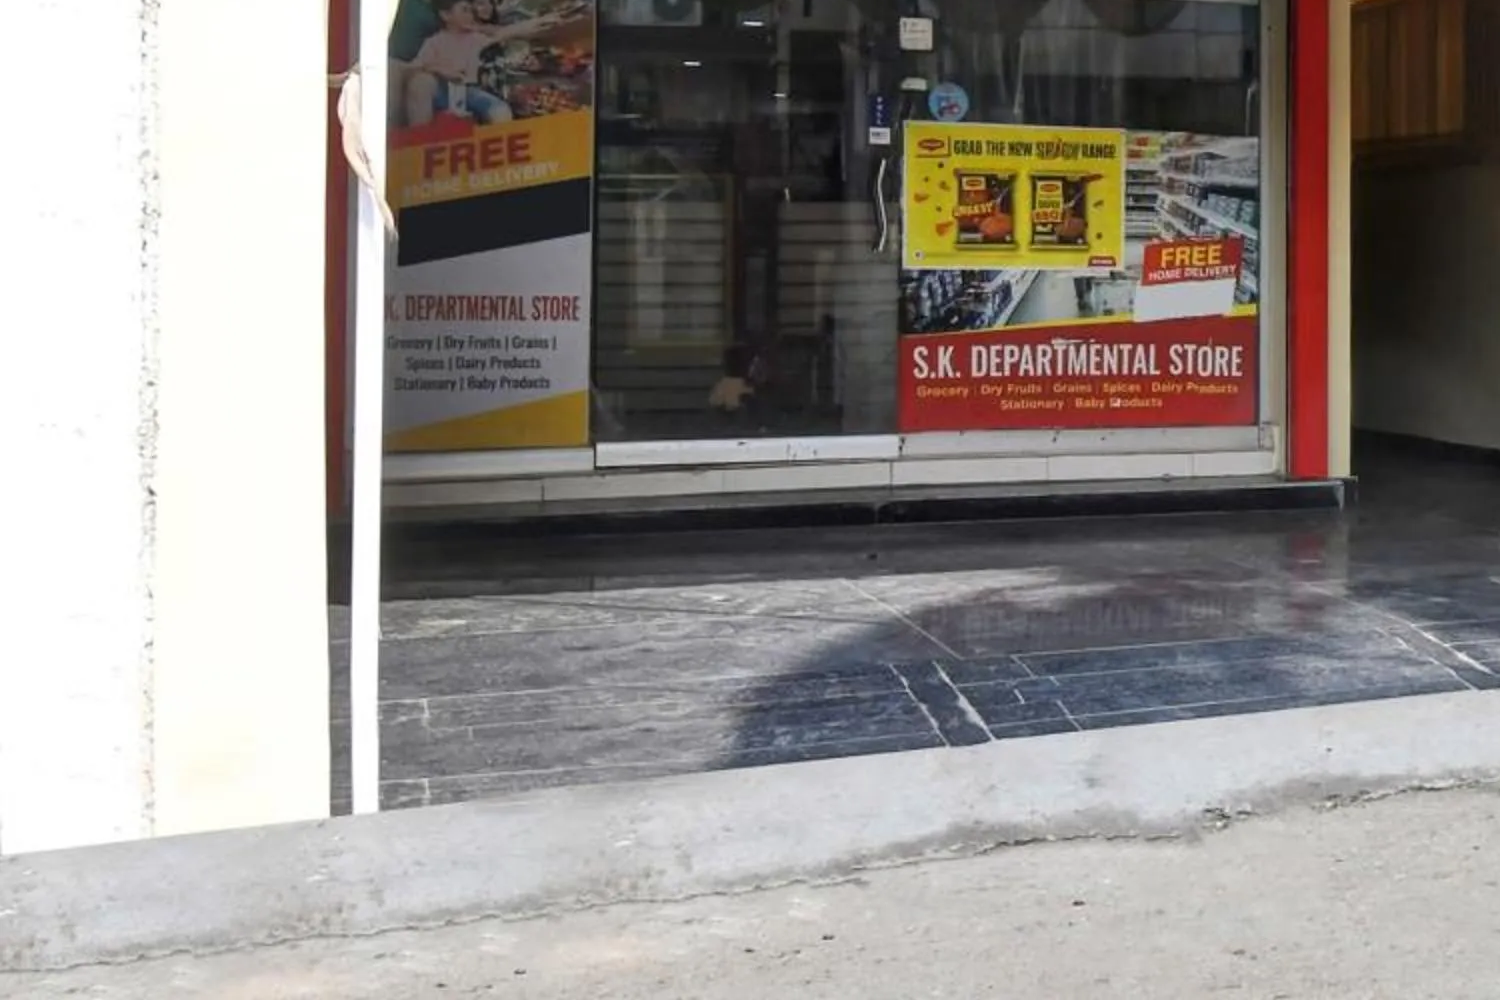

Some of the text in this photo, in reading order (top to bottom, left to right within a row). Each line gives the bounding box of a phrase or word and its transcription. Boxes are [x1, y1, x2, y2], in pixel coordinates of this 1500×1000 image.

[423, 131, 532, 180] FREE
[954, 140, 983, 155] GRAB
[986, 140, 1006, 156] THE
[1009, 141, 1033, 156] NEW
[1082, 143, 1116, 158] RANGE
[470, 161, 560, 188] DELIVERY
[1161, 244, 1223, 267] FREE
[1148, 264, 1237, 281] HOME DELIVERY
[405, 295, 527, 322] DEPARTMENTAL
[531, 296, 581, 322] STORE
[443, 336, 465, 350] Dry
[469, 335, 502, 349] Fruits
[511, 336, 549, 349] Grains
[455, 356, 486, 371] Dairy
[490, 356, 541, 370] Products
[913, 343, 1243, 379] S.K. DEPARTMENTAL STORE
[467, 377, 498, 391] Baby
[500, 377, 550, 390] Products
[916, 381, 1239, 398] Grocery Dry Fruits Grains Spices Dairy Products
[1001, 400, 1065, 412] Stationary
[1075, 397, 1105, 409] Baby
